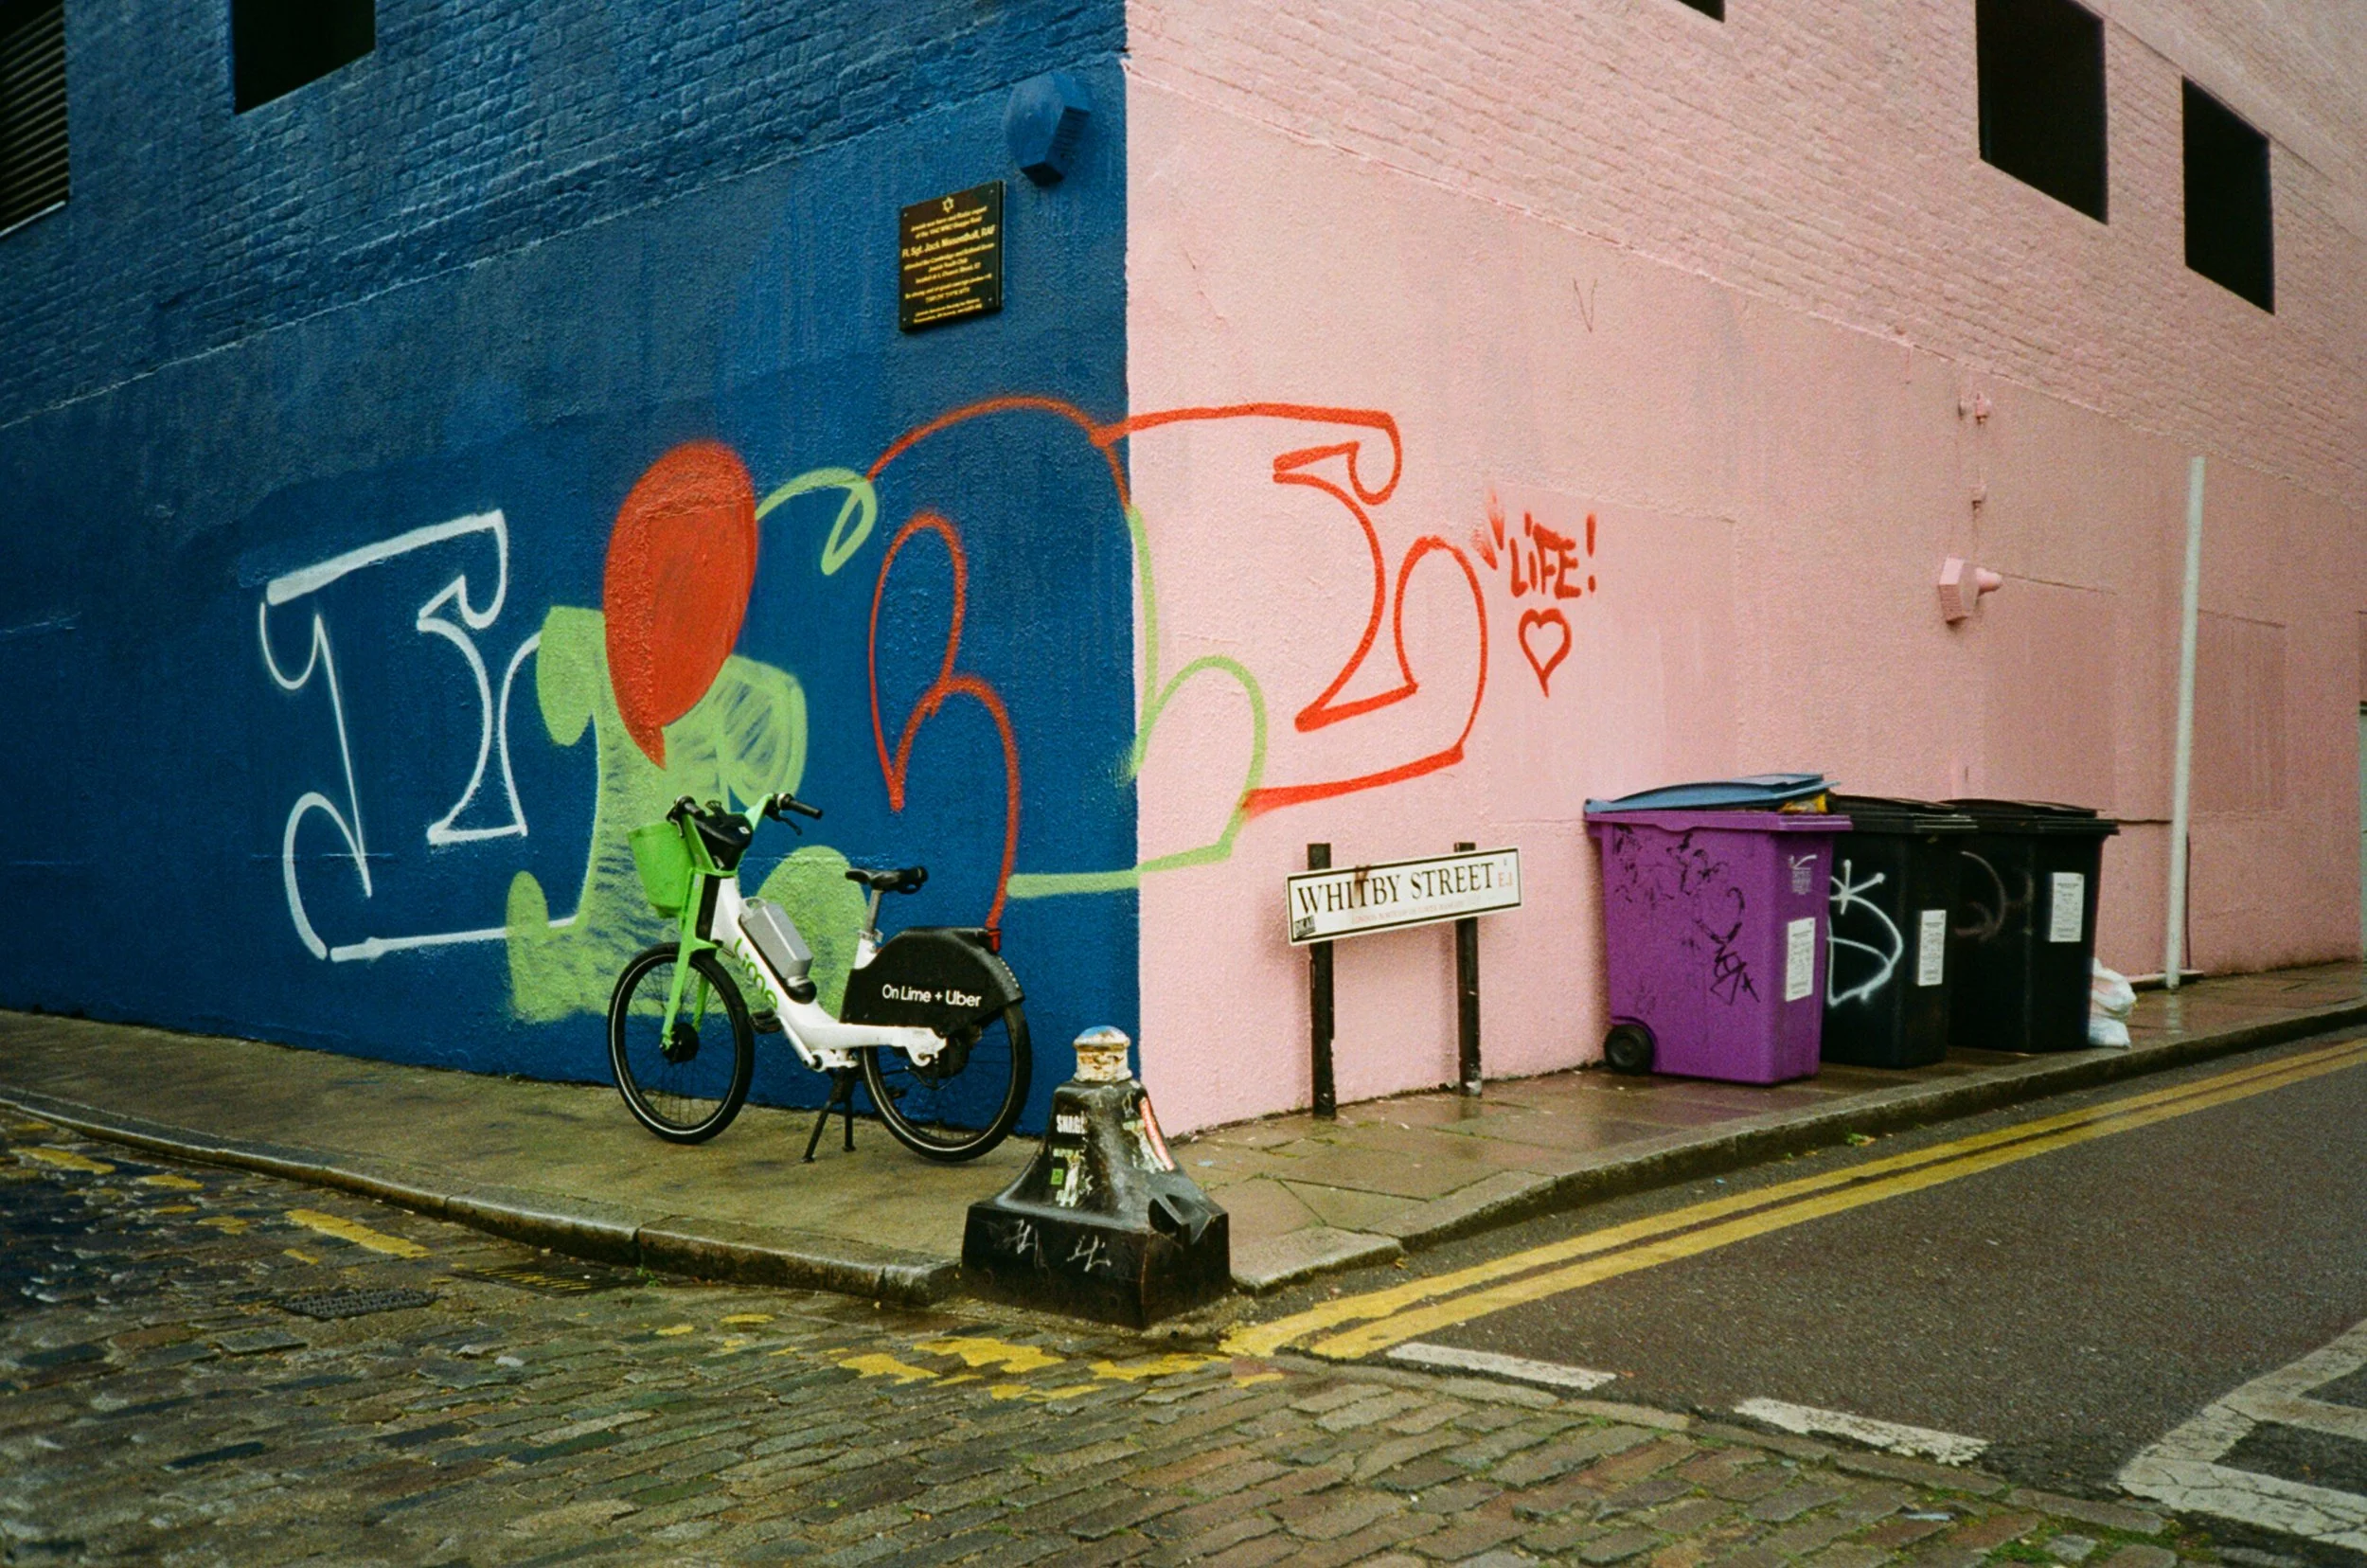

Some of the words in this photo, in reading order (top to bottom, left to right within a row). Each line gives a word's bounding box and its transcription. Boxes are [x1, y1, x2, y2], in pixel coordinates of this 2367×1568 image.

[1297, 873, 1401, 914] WHITBY
[1411, 862, 1495, 900] STREET
[734, 936, 778, 1010] Lime
[882, 984, 899, 999] On
[900, 986, 932, 1003] Lime
[934, 991, 943, 1002] +
[946, 989, 982, 1007] Uber
